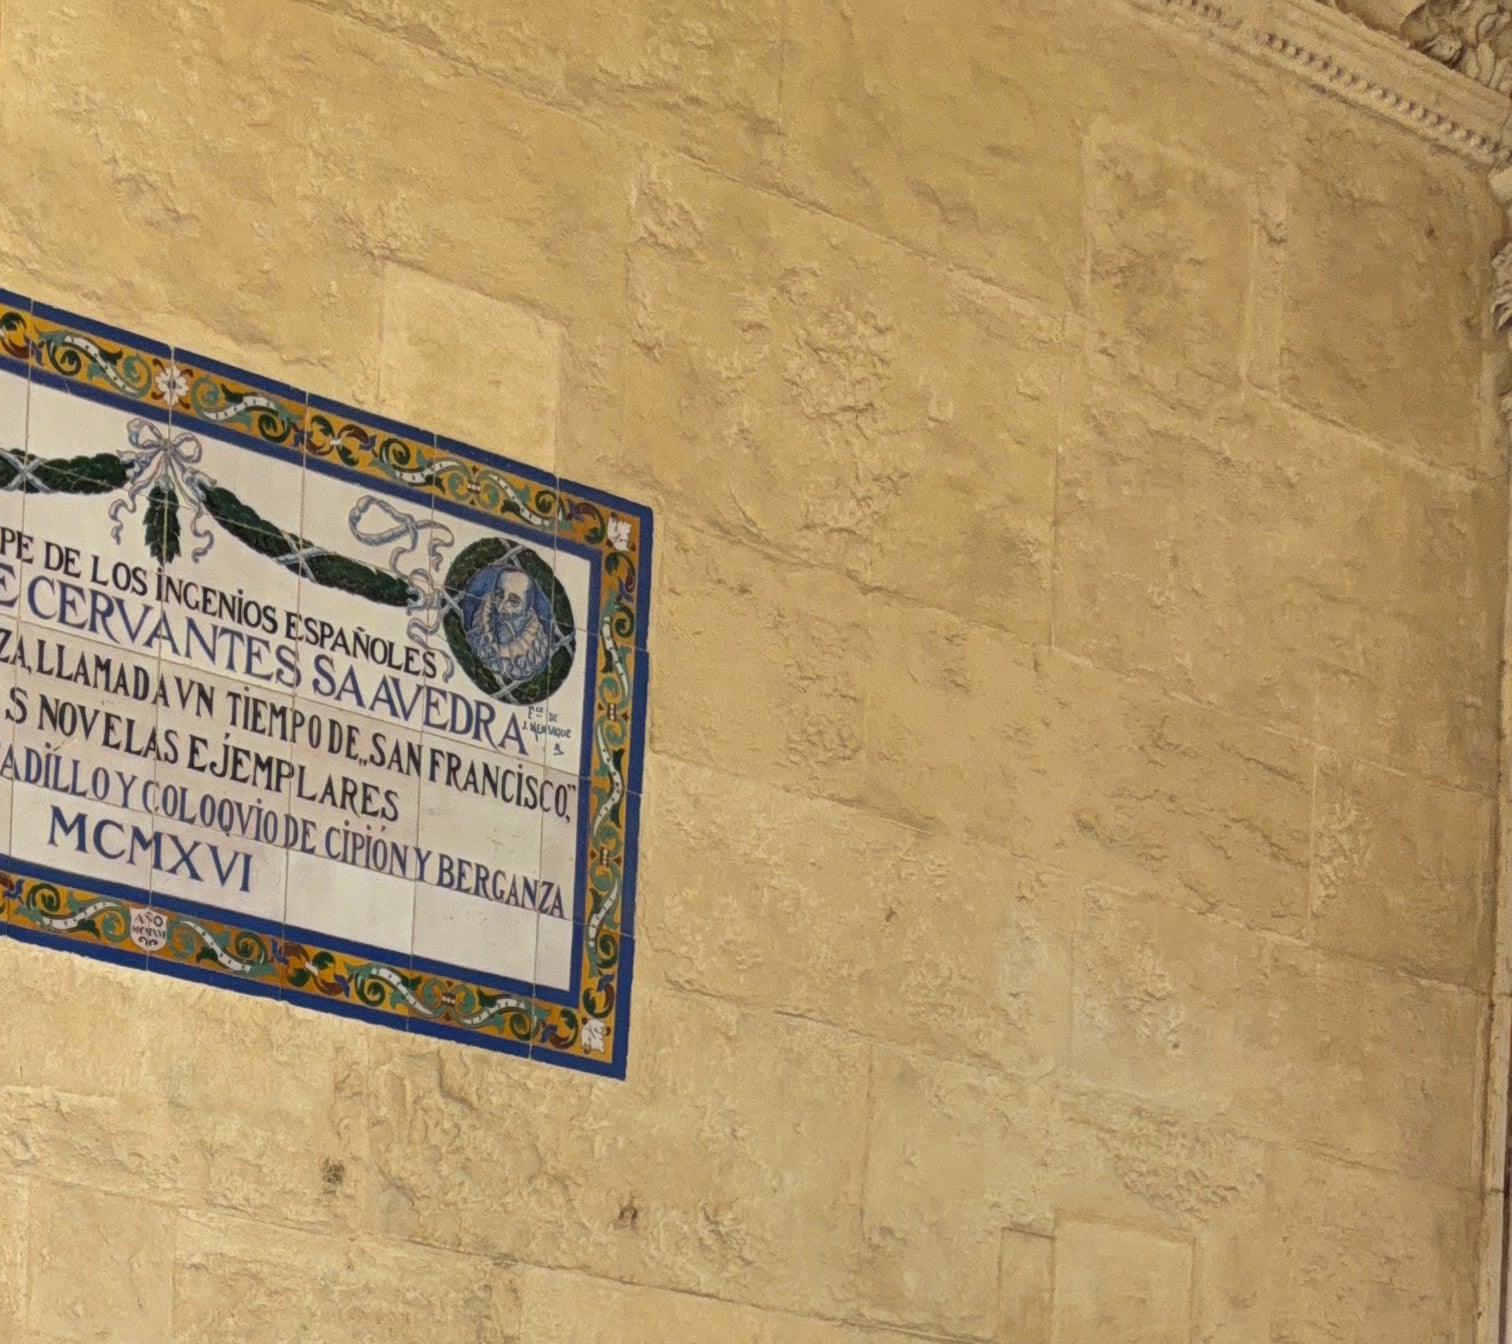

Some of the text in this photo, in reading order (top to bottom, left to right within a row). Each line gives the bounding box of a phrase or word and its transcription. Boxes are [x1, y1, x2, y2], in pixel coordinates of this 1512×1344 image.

[27, 575, 302, 689] CERVANTES
[312, 654, 529, 756] SAAVEDRA
[43, 540, 82, 578] DE
[90, 555, 148, 596] LOS
[156, 567, 278, 635] INGENIOS
[284, 610, 437, 679] ESPAÑOLES
[36, 638, 170, 708] LLAMADA
[173, 675, 215, 719] VN
[226, 686, 322, 749] TIEMPO
[328, 718, 360, 760] DE
[37, 693, 180, 765] NOVELAS
[187, 732, 400, 822] EJEMPLARES
[47, 803, 253, 893] MCMXVI
[115, 769, 138, 808] Y
[142, 779, 278, 844] COLOQVIO
[283, 813, 317, 854] DE
[325, 819, 409, 877] CIPIÓN
[413, 846, 431, 882] Y
[438, 852, 566, 919] BERGANZA
